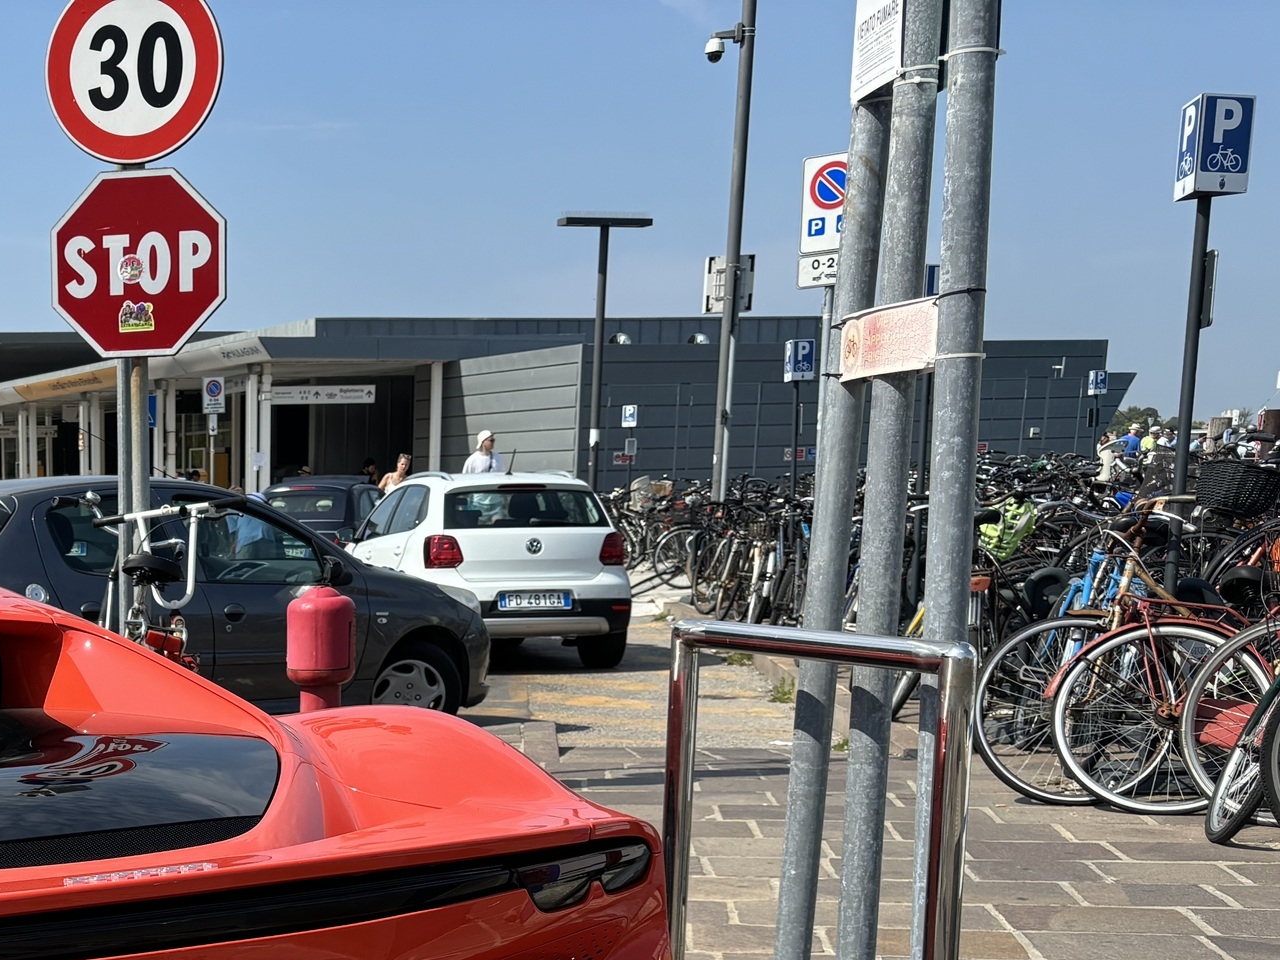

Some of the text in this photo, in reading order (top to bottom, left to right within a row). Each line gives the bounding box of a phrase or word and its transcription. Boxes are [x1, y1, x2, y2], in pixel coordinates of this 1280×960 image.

[88, 20, 183, 112] 30
[1182, 104, 1196, 152] P
[1212, 98, 1243, 144] P
[811, 219, 823, 235] P
[64, 230, 212, 299] STOP
[811, 257, 839, 270] 0-2
[798, 341, 810, 361] P
[1097, 371, 1105, 383] P
[625, 405, 635, 417] P
[507, 593, 522, 606] FD
[527, 593, 563, 606] 481GA
